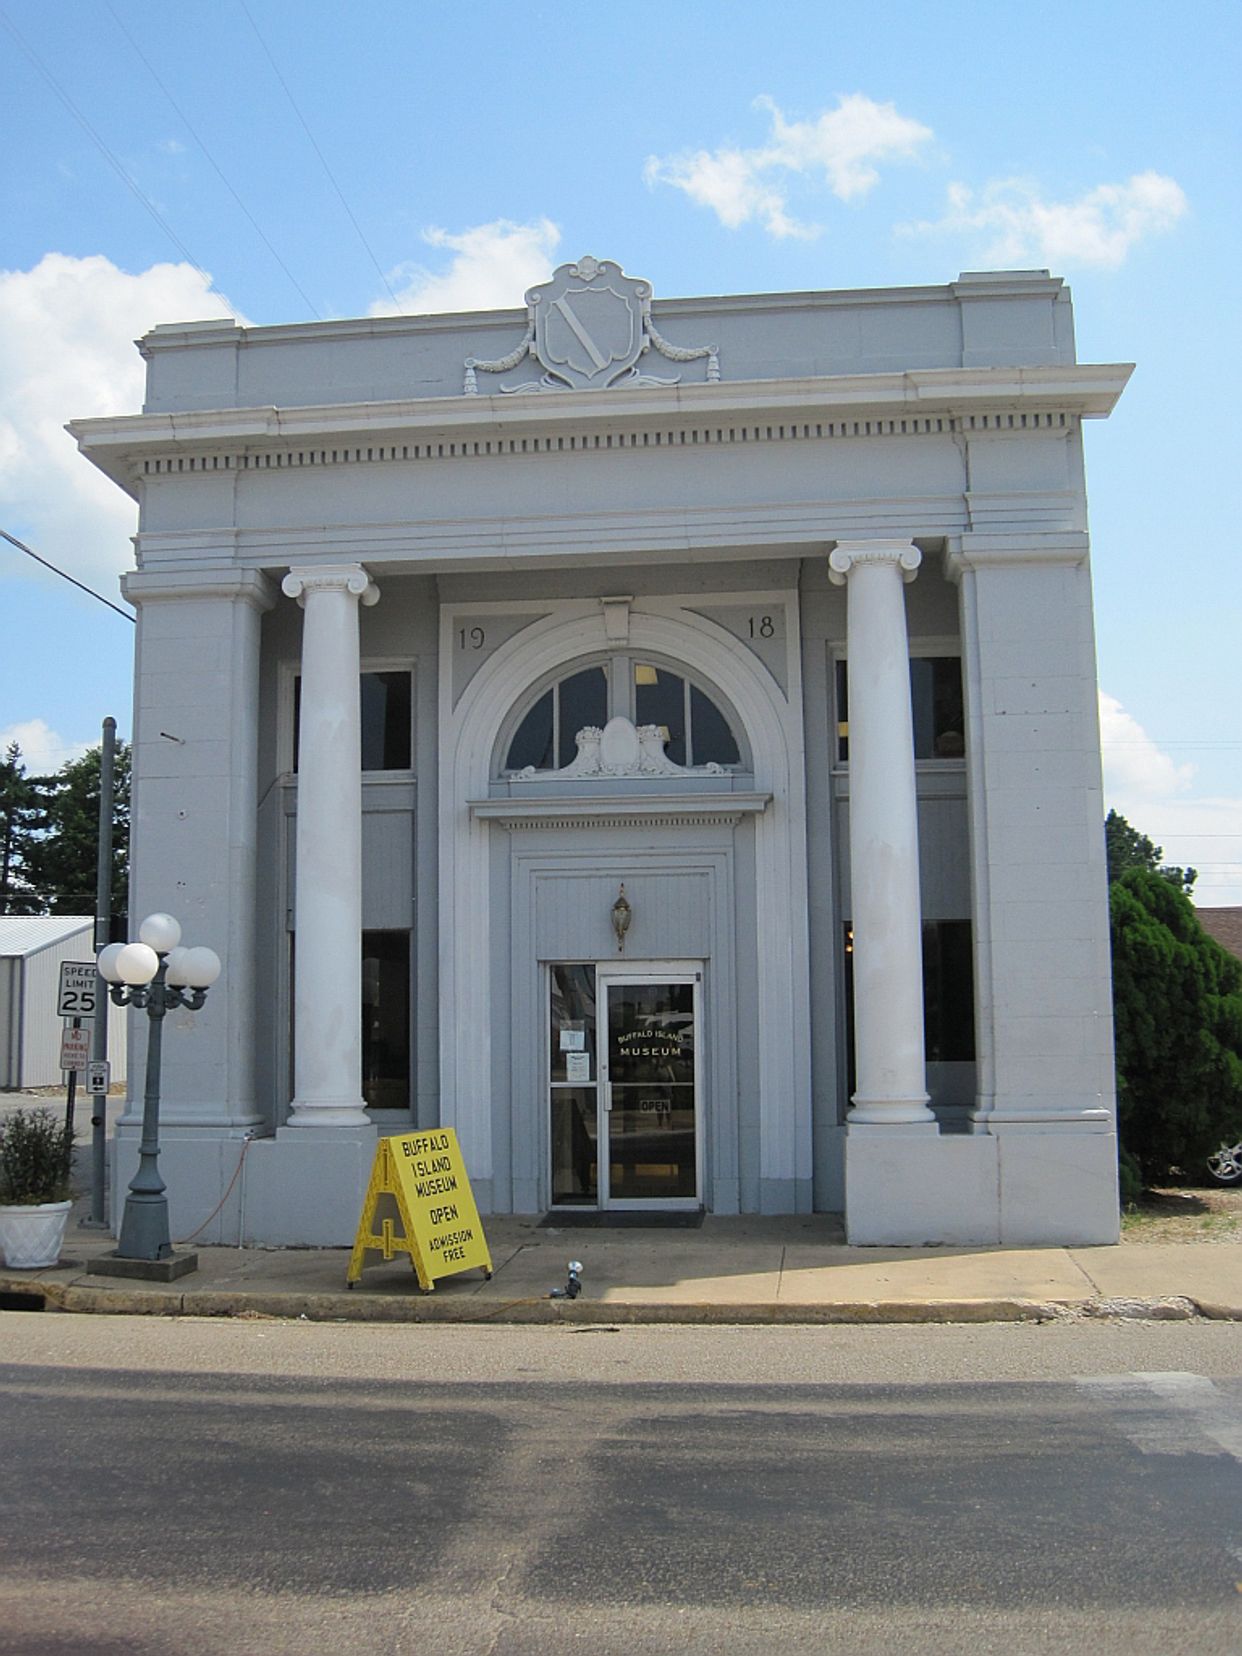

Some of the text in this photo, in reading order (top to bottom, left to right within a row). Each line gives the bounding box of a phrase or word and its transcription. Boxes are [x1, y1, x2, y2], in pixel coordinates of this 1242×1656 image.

[460, 616, 774, 650] 19 18
[66, 980, 94, 988] LIMIT
[62, 992, 95, 1012] 25
[617, 1030, 684, 1044] BUFFALO ISLAND
[620, 1047, 681, 1056] MUSEUM
[641, 1101, 669, 1111] OPEN
[402, 1134, 449, 1157] BUFFALO
[411, 1156, 451, 1178] ISLAND
[415, 1176, 457, 1198] MUSEUM
[430, 1204, 459, 1225] OPEN
[429, 1229, 473, 1252] ADMISSION
[443, 1246, 466, 1263] FREE
